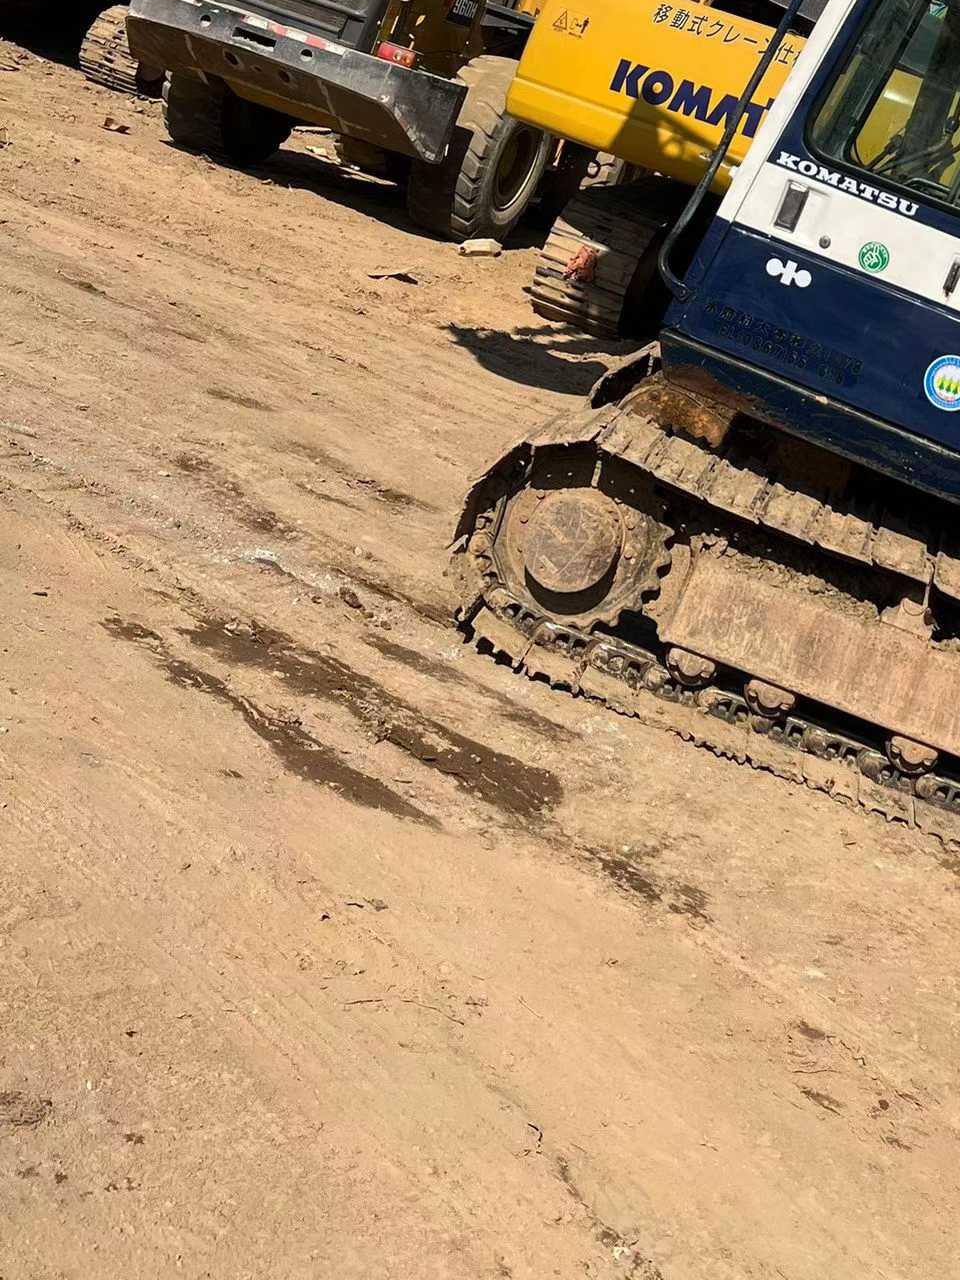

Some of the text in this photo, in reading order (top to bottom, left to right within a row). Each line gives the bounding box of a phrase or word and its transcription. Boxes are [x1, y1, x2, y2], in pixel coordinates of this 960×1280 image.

[653, 3, 801, 66] 移動式クレーン仕
[775, 151, 920, 217] KOMATSU
